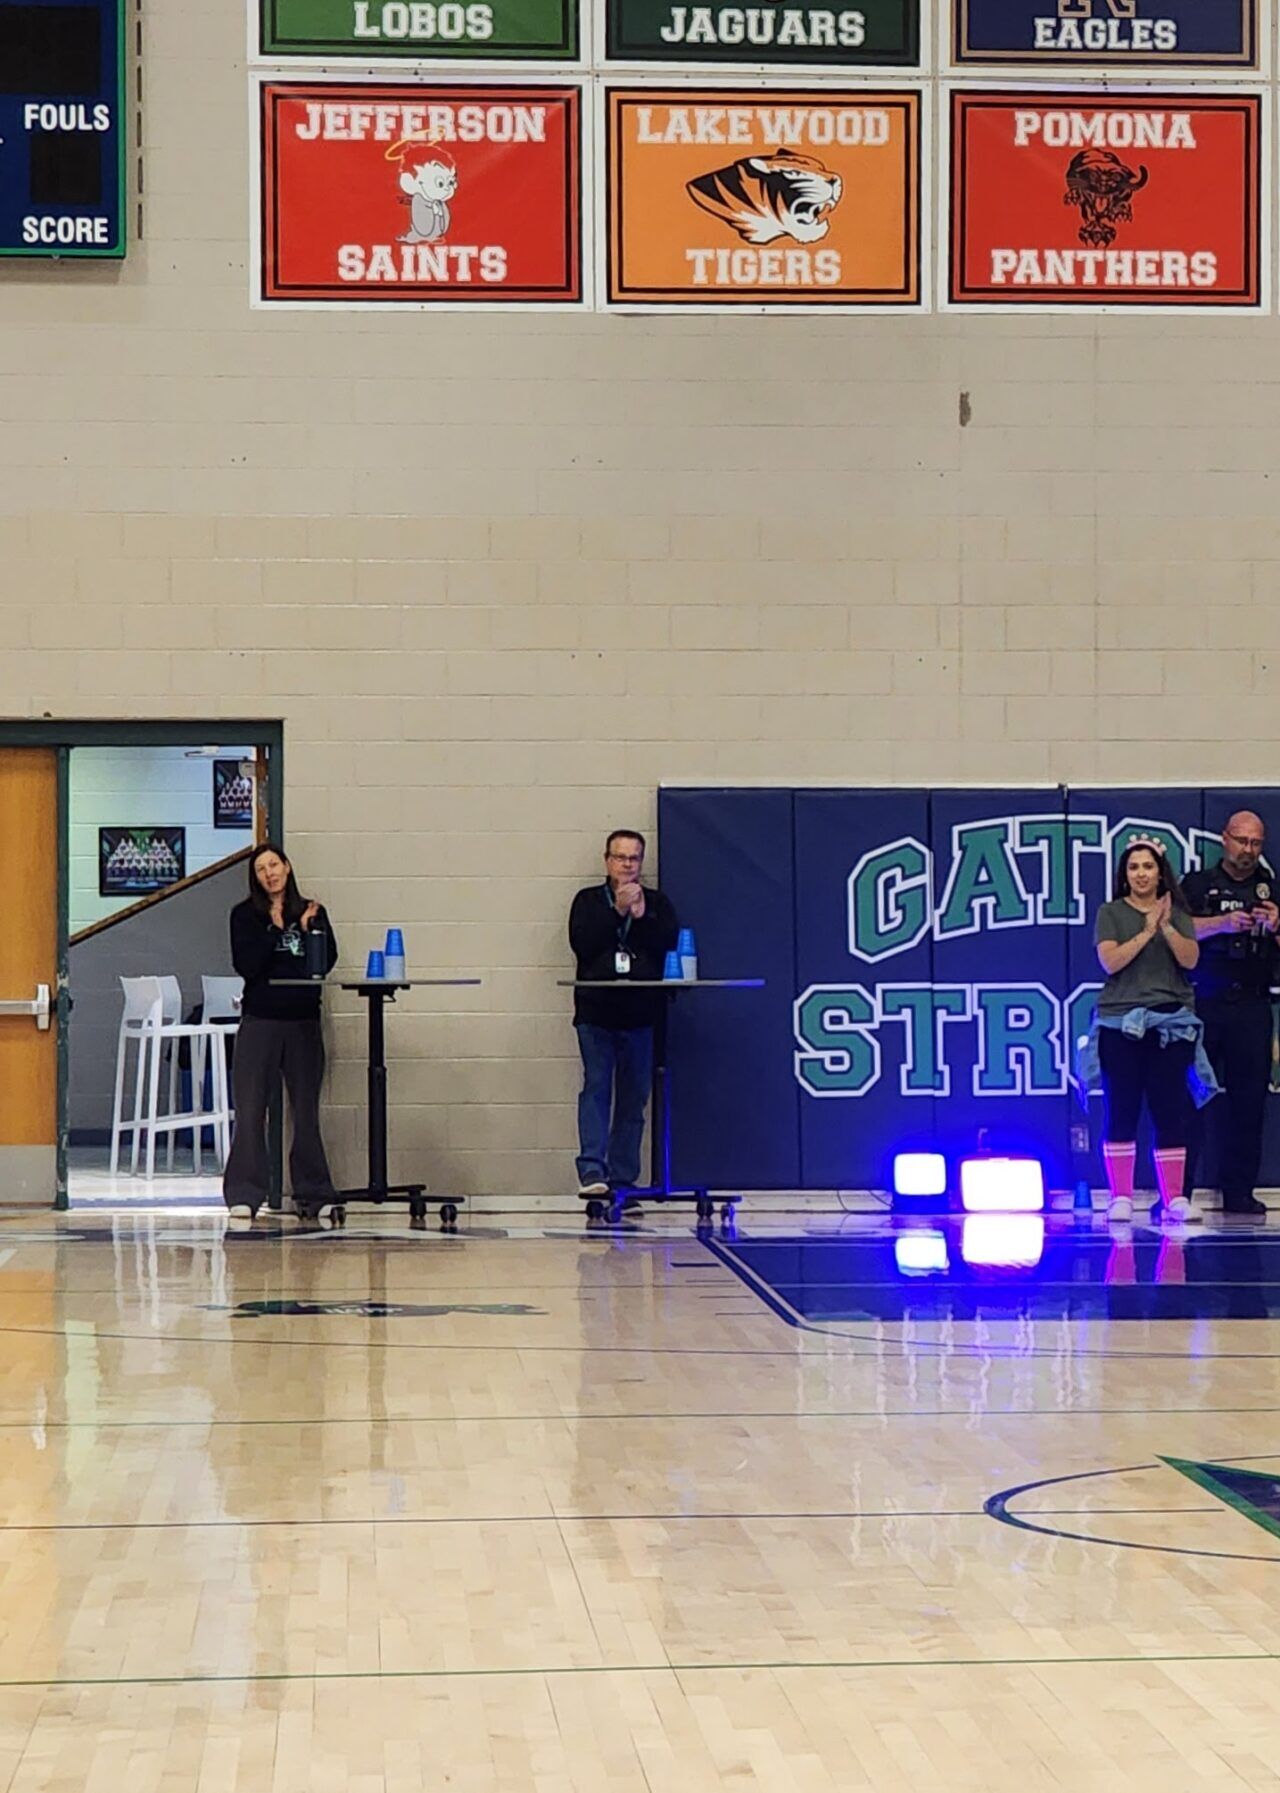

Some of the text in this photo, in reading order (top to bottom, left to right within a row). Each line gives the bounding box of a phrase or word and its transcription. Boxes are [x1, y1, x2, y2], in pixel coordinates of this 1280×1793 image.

[354, 2, 494, 39] LOBOS
[660, 7, 865, 46] JAGUARS
[1034, 17, 1177, 49] EAGLES
[24, 103, 110, 131] FOULS
[295, 103, 546, 142] JEFFERSON
[636, 106, 890, 146] LAKEWOOD
[1014, 111, 1197, 148] POMONA
[23, 215, 108, 244] SCORE
[338, 244, 508, 282] SAINTS
[685, 248, 841, 286] TIGERS
[990, 249, 1218, 287] PANTHERS
